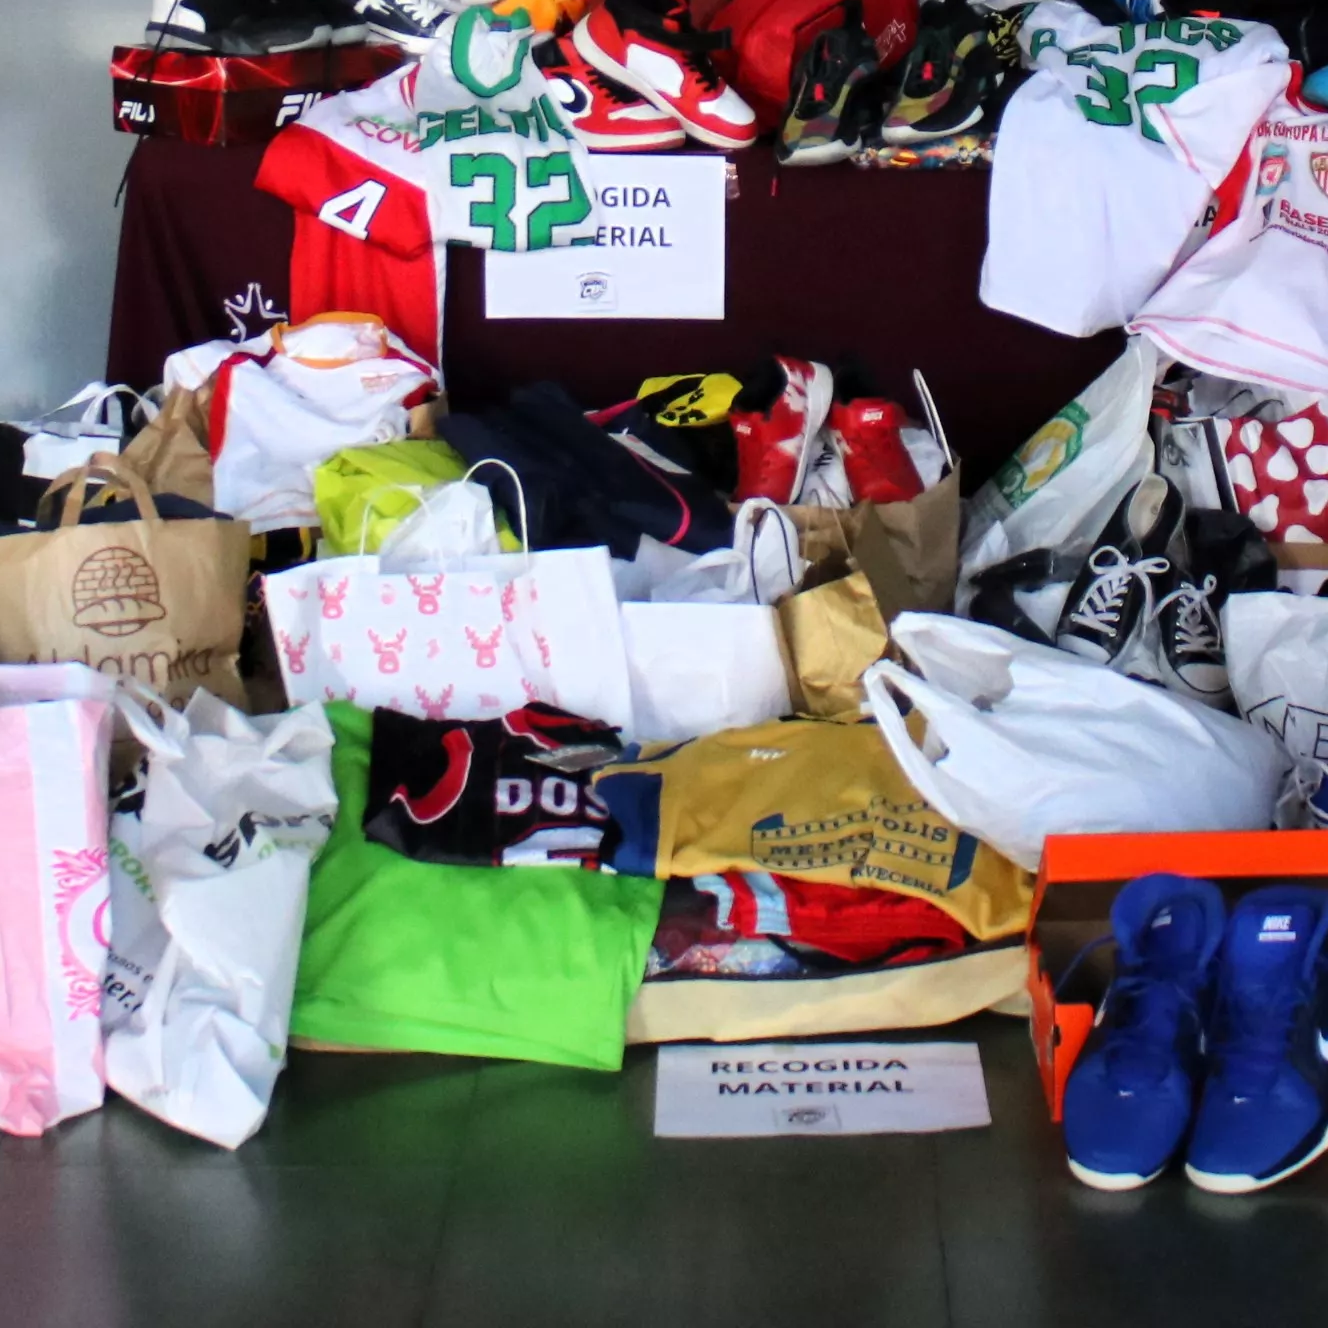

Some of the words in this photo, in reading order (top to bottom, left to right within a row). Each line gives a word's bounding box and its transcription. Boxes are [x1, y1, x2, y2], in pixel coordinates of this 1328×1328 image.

[1075, 48, 1200, 145] 32
[355, 118, 422, 154] COV
[1273, 121, 1319, 142] EUROPA
[317, 178, 388, 241] 4
[450, 151, 593, 253] 32
[593, 186, 671, 208] GIDA
[711, 1059, 908, 1074] RECOGIDA
[718, 1080, 915, 1095] MATERIAL
